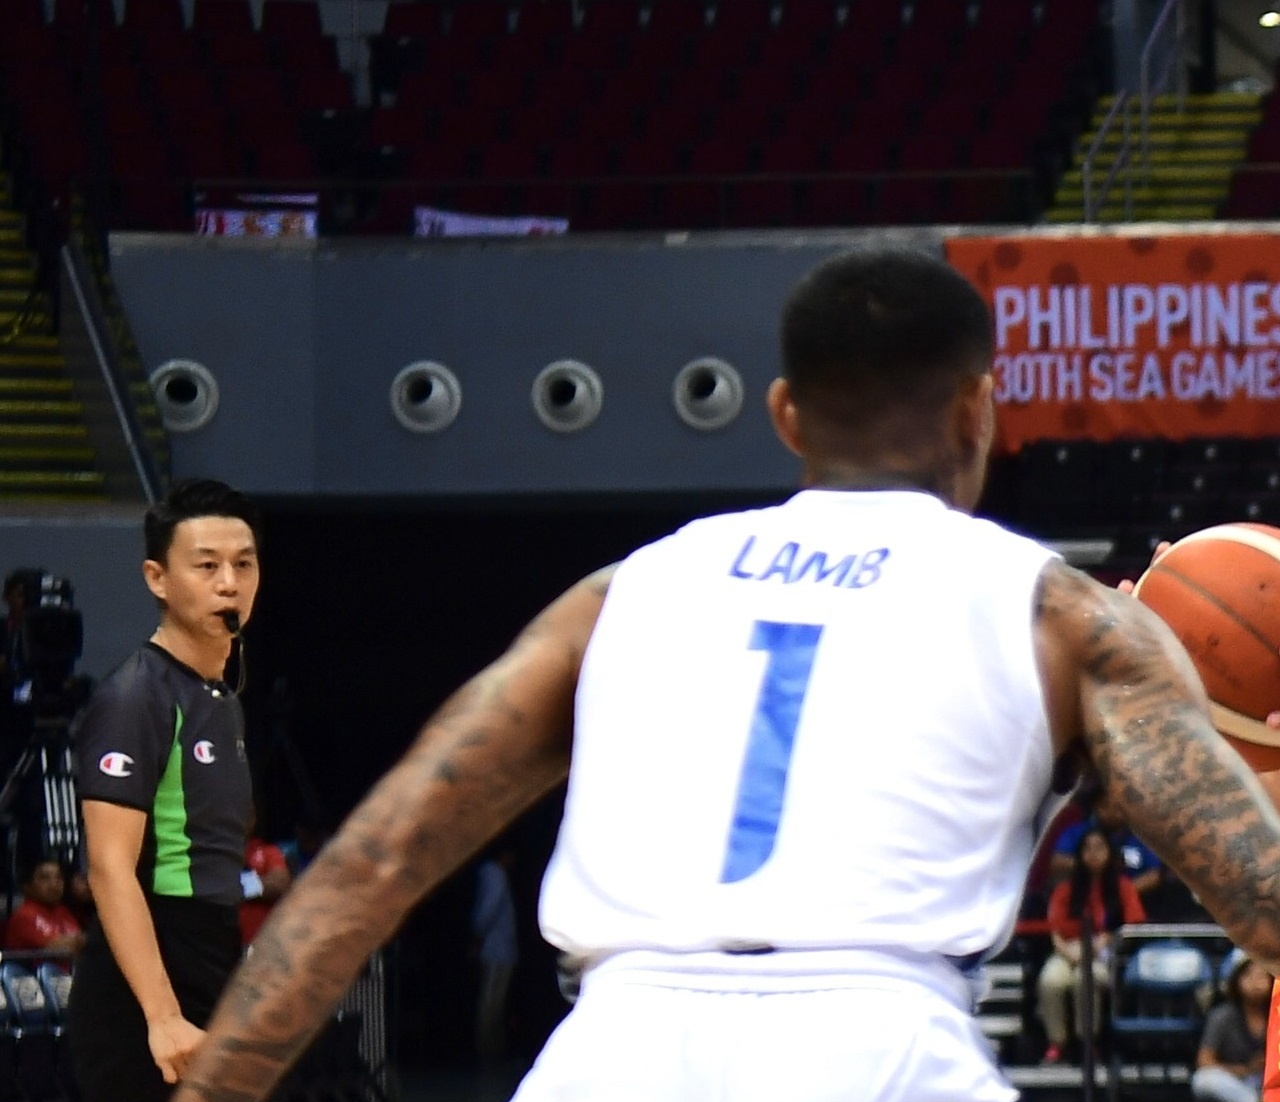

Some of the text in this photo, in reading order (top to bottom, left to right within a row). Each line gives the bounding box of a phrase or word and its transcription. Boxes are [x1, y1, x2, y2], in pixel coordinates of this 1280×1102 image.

[993, 353, 1083, 404] 30TH
[1088, 350, 1166, 402] SEA
[728, 535, 890, 589] LAMB
[717, 620, 825, 884] 1
